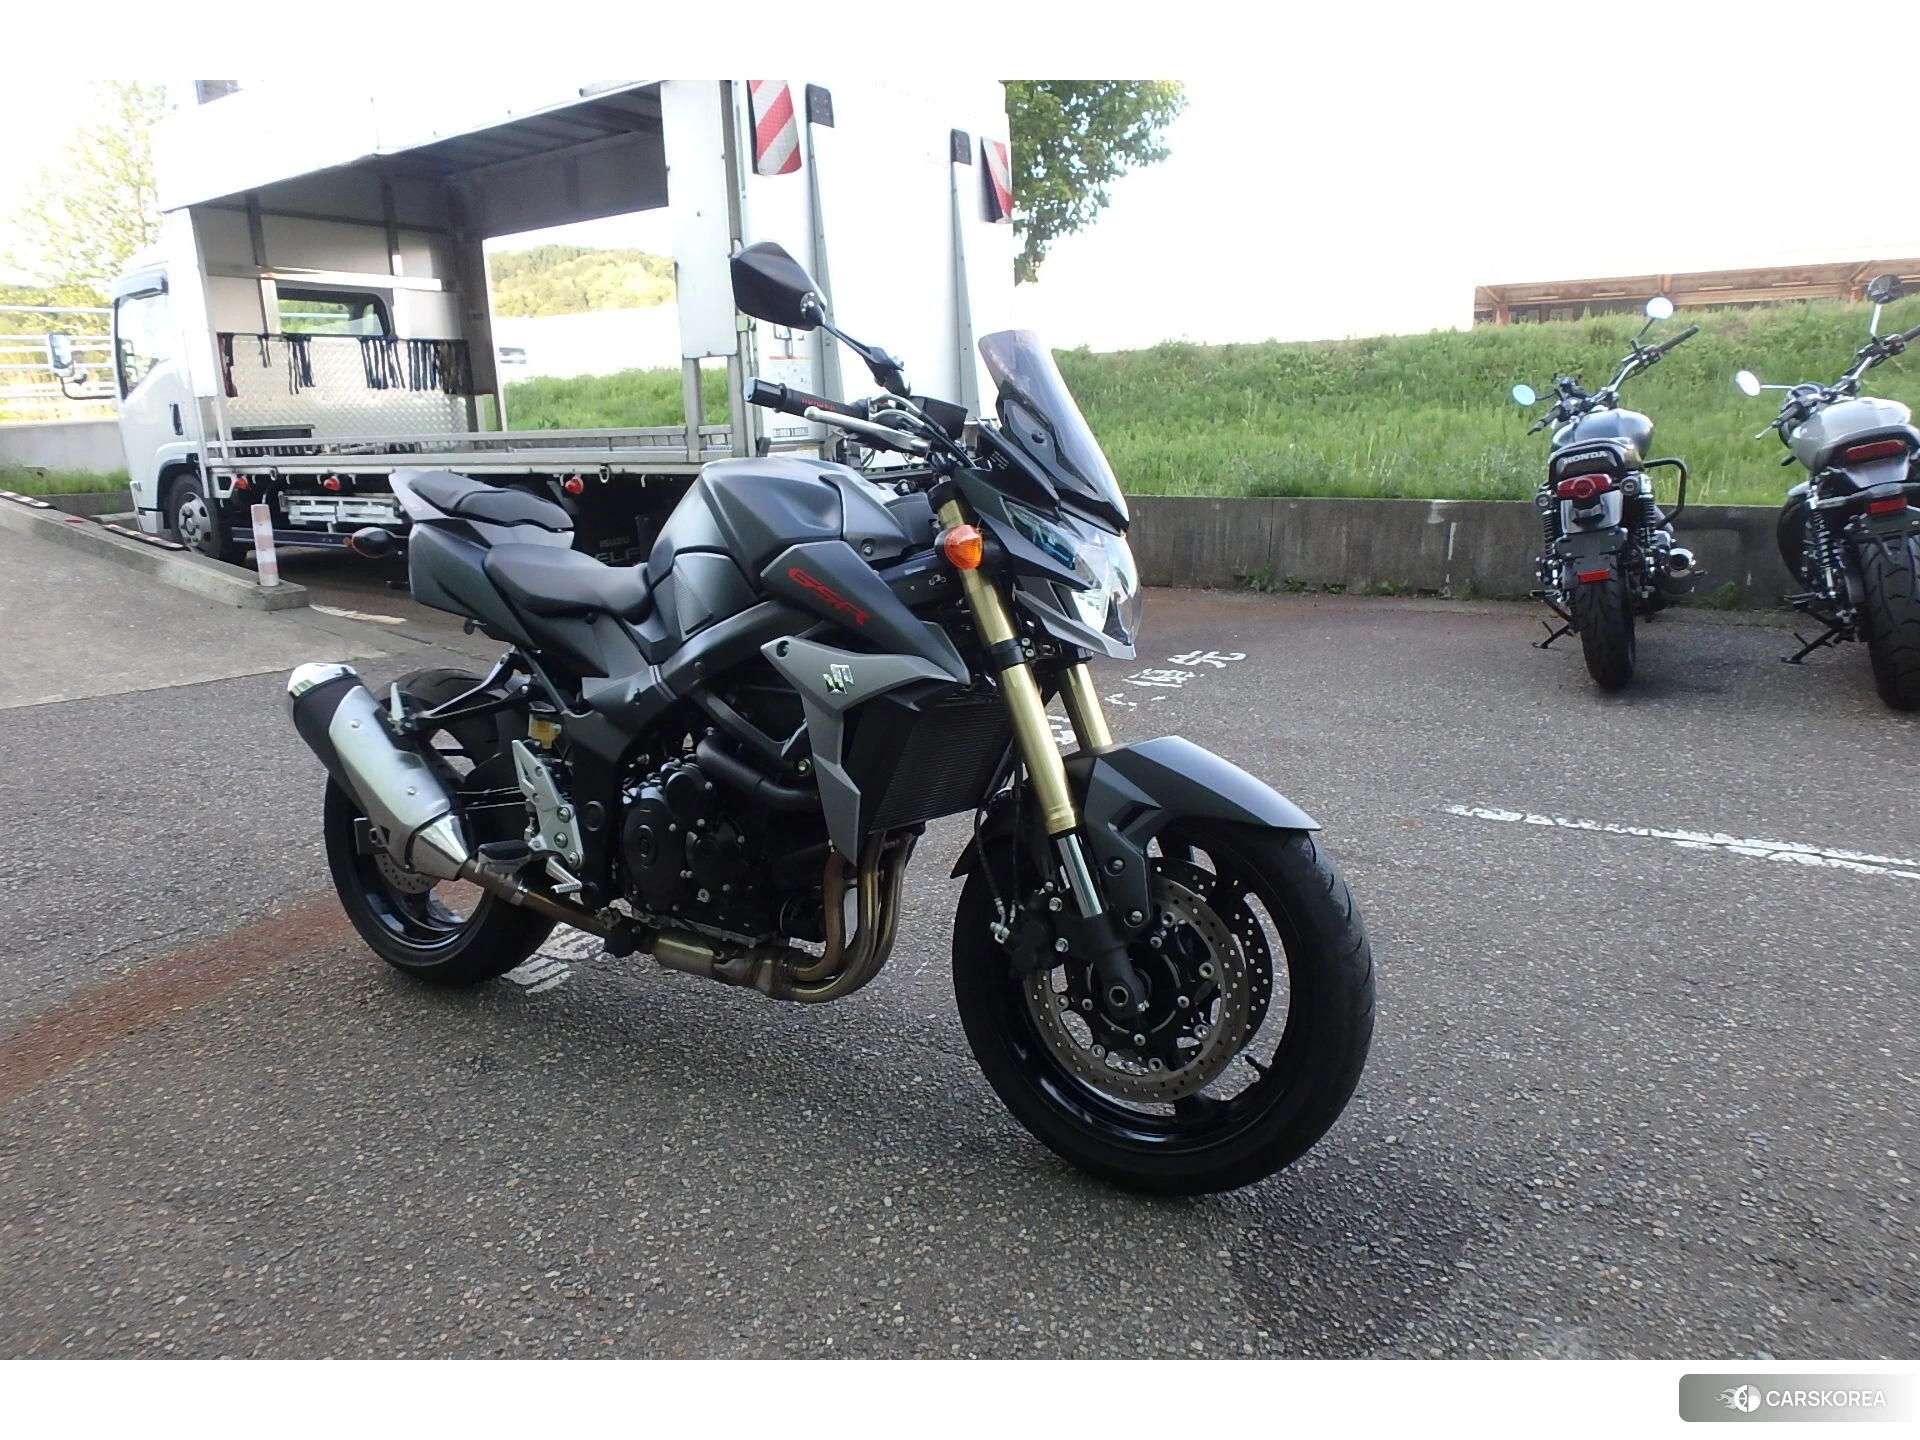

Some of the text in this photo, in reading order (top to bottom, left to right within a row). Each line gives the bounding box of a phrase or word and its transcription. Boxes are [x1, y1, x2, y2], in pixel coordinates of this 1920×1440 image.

[1563, 450, 1608, 465] HONDA
[599, 537, 630, 548] ISUZU
[595, 547, 640, 564] ELF
[787, 566, 871, 626] GSR
